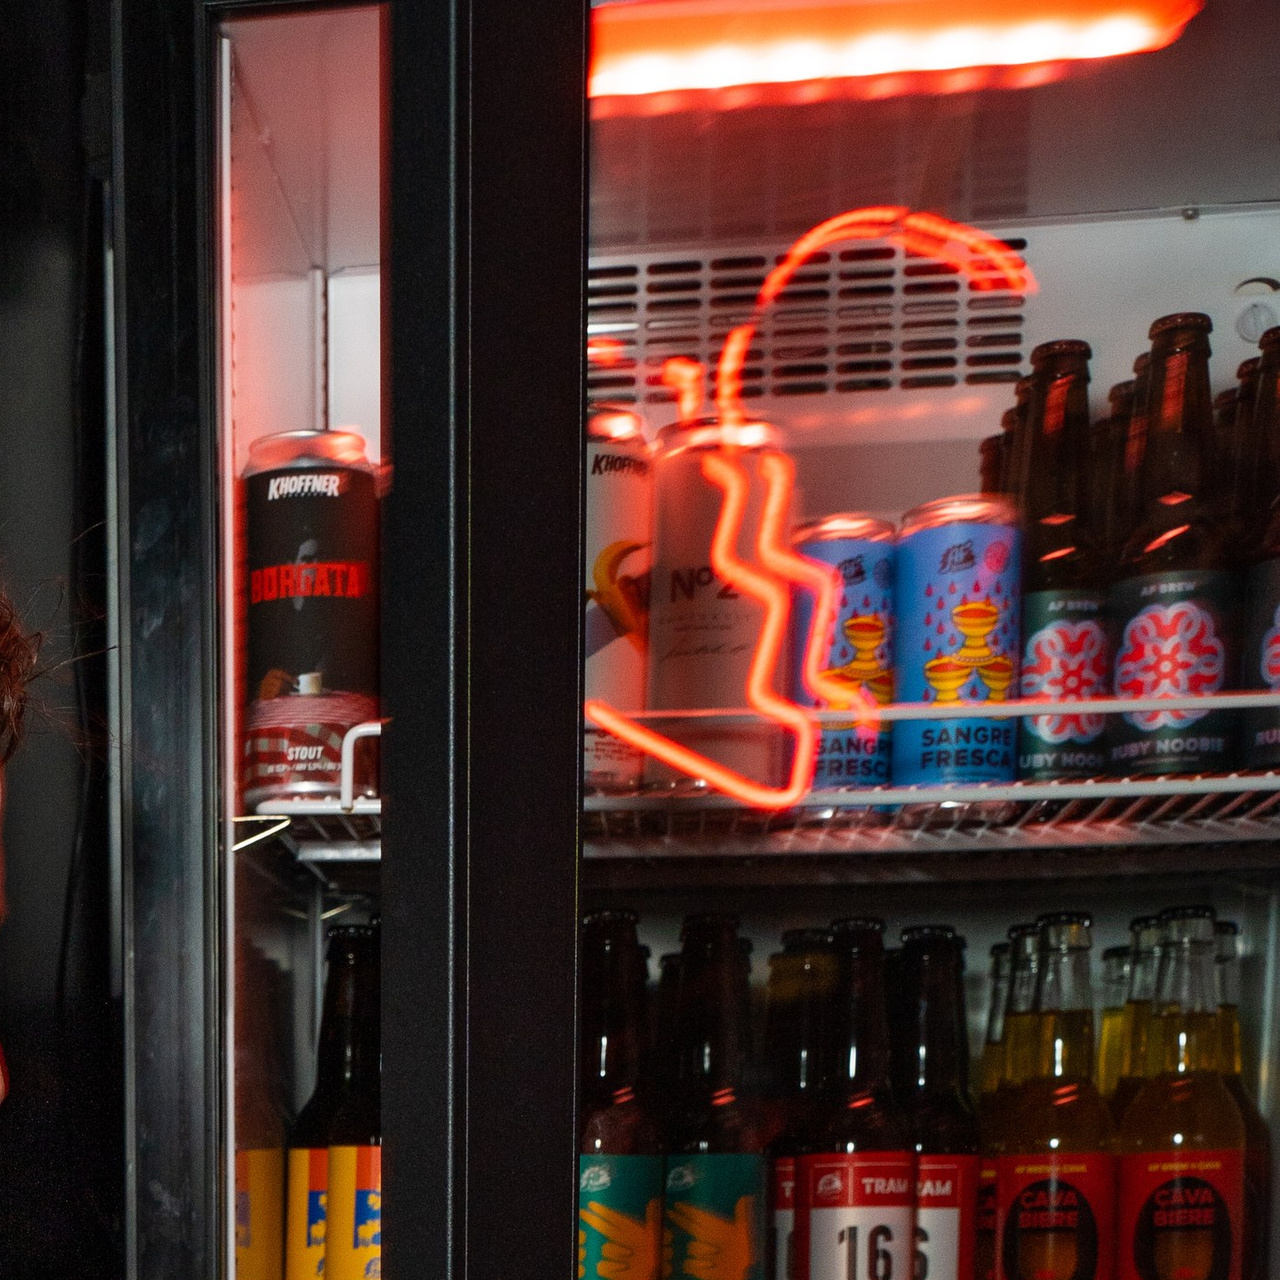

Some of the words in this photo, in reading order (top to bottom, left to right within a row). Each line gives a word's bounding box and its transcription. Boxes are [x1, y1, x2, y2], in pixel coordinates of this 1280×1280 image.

[268, 475, 340, 501] KHOFFNER
[922, 727, 1012, 747] SANGRE
[287, 745, 324, 761] STOUT
[815, 739, 890, 758] SANGR
[815, 759, 890, 779] FRESC
[921, 749, 1011, 769] FRESCA
[1019, 755, 1056, 769] UBY
